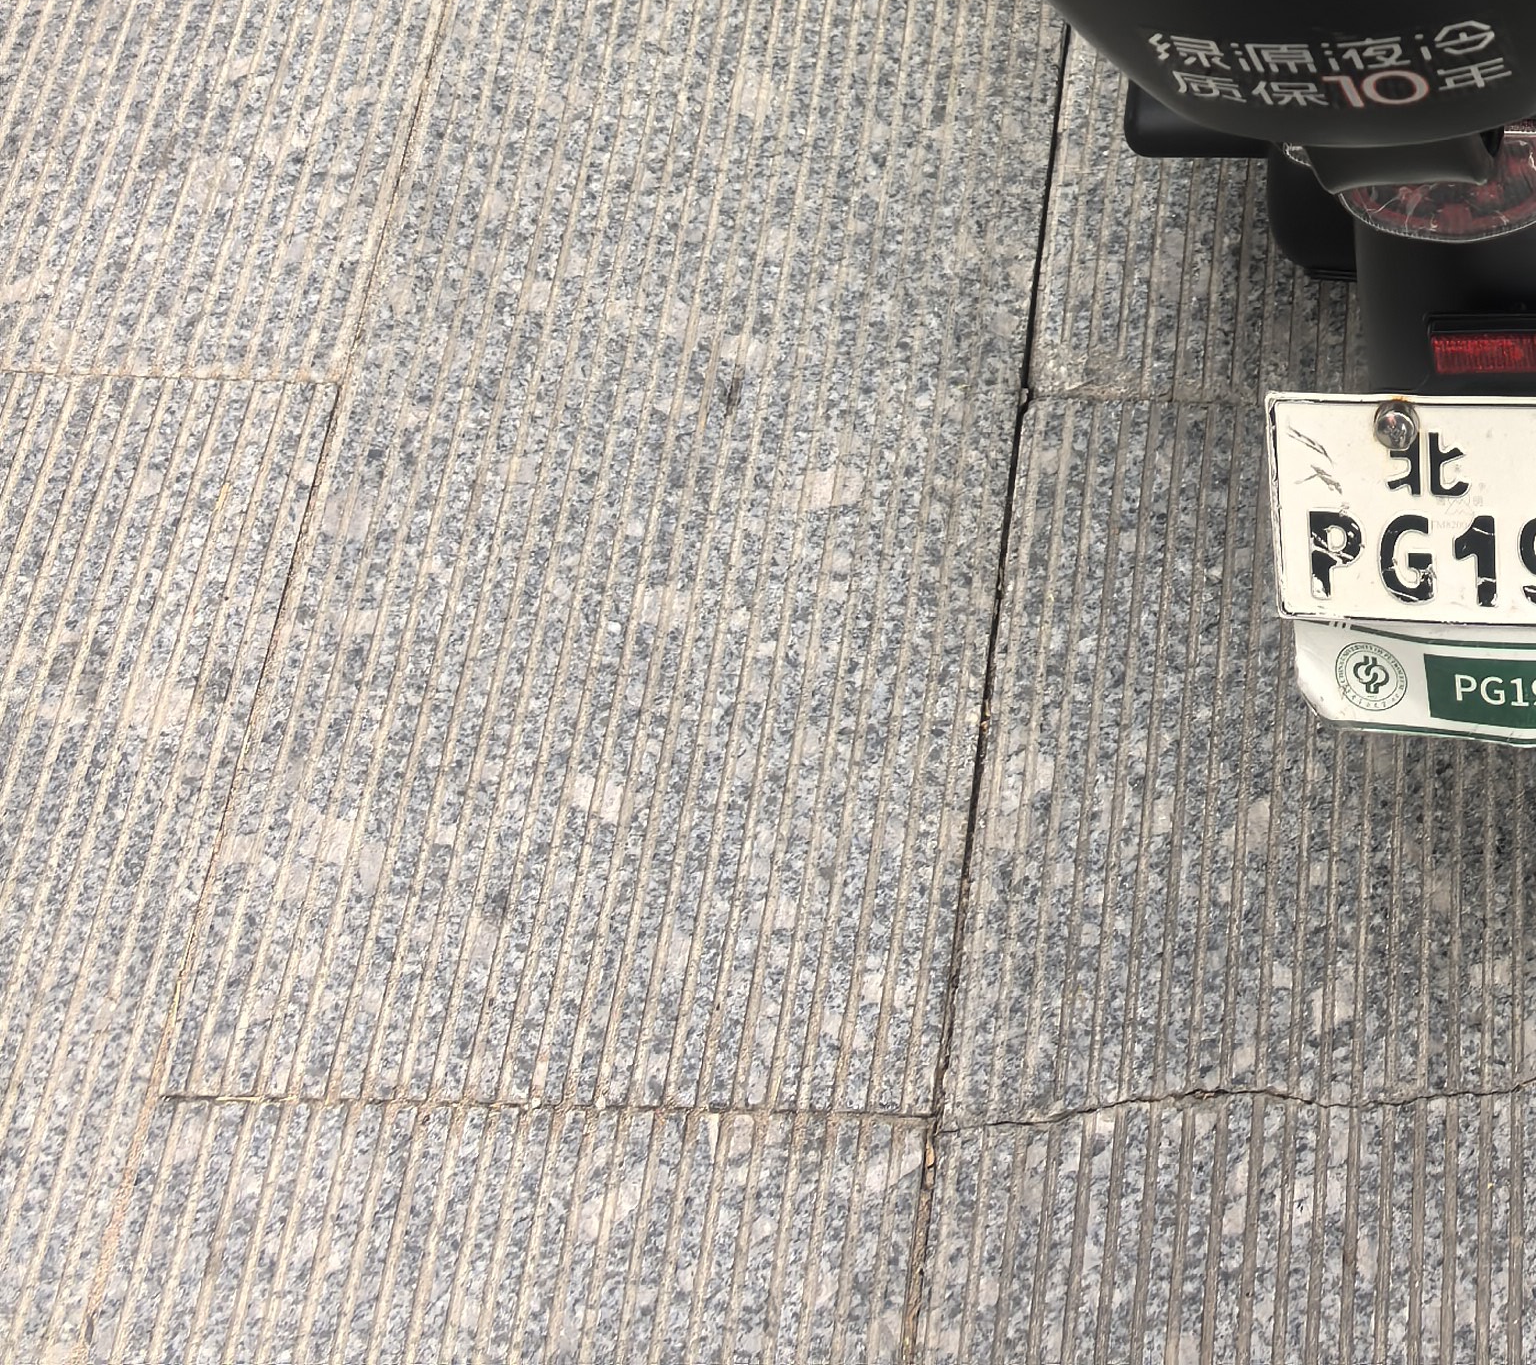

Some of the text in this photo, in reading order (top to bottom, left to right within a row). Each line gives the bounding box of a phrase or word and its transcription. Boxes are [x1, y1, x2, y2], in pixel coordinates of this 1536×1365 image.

[1148, 19, 1495, 74] 绿源液冷
[1173, 55, 1513, 109] 质保10年
